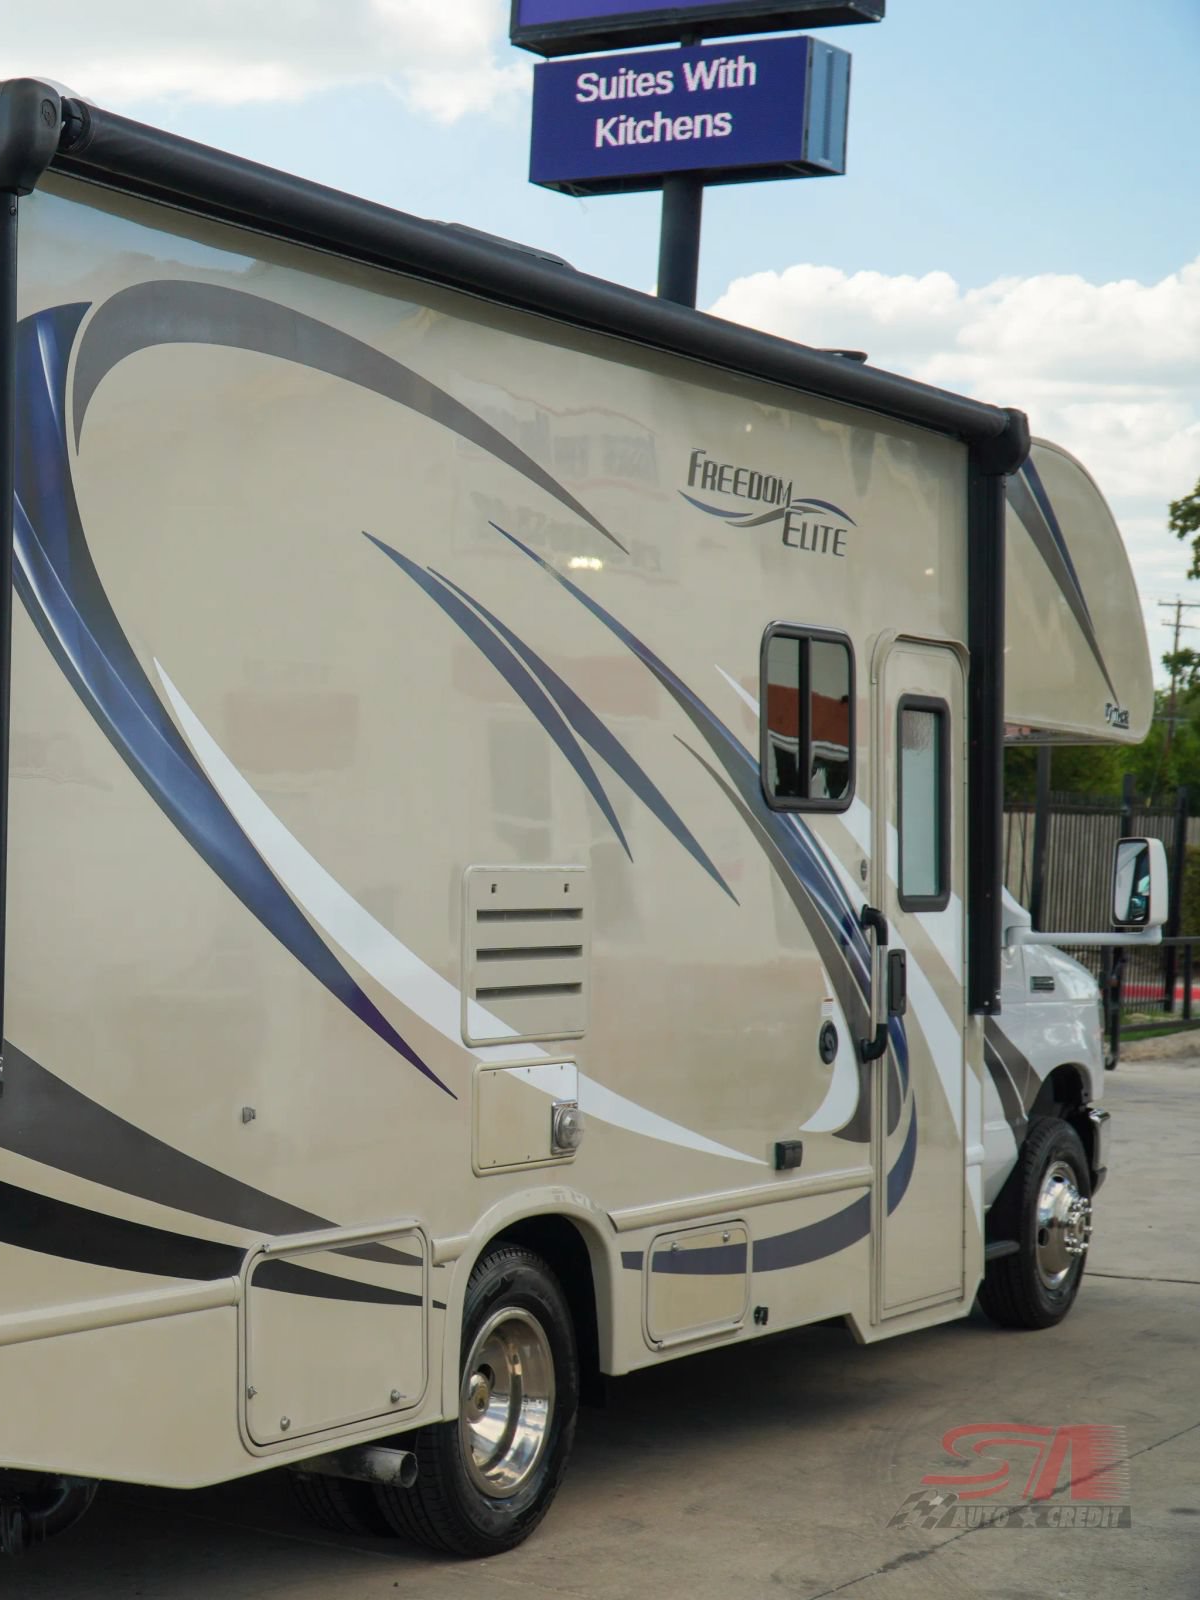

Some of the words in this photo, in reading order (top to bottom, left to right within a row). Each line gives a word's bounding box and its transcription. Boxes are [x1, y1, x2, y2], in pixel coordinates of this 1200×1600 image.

[576, 68, 674, 102] Suites
[683, 55, 756, 91] With
[596, 111, 732, 147] Kitchens
[687, 448, 793, 508] FREEDOM
[782, 511, 848, 557] ELITE
